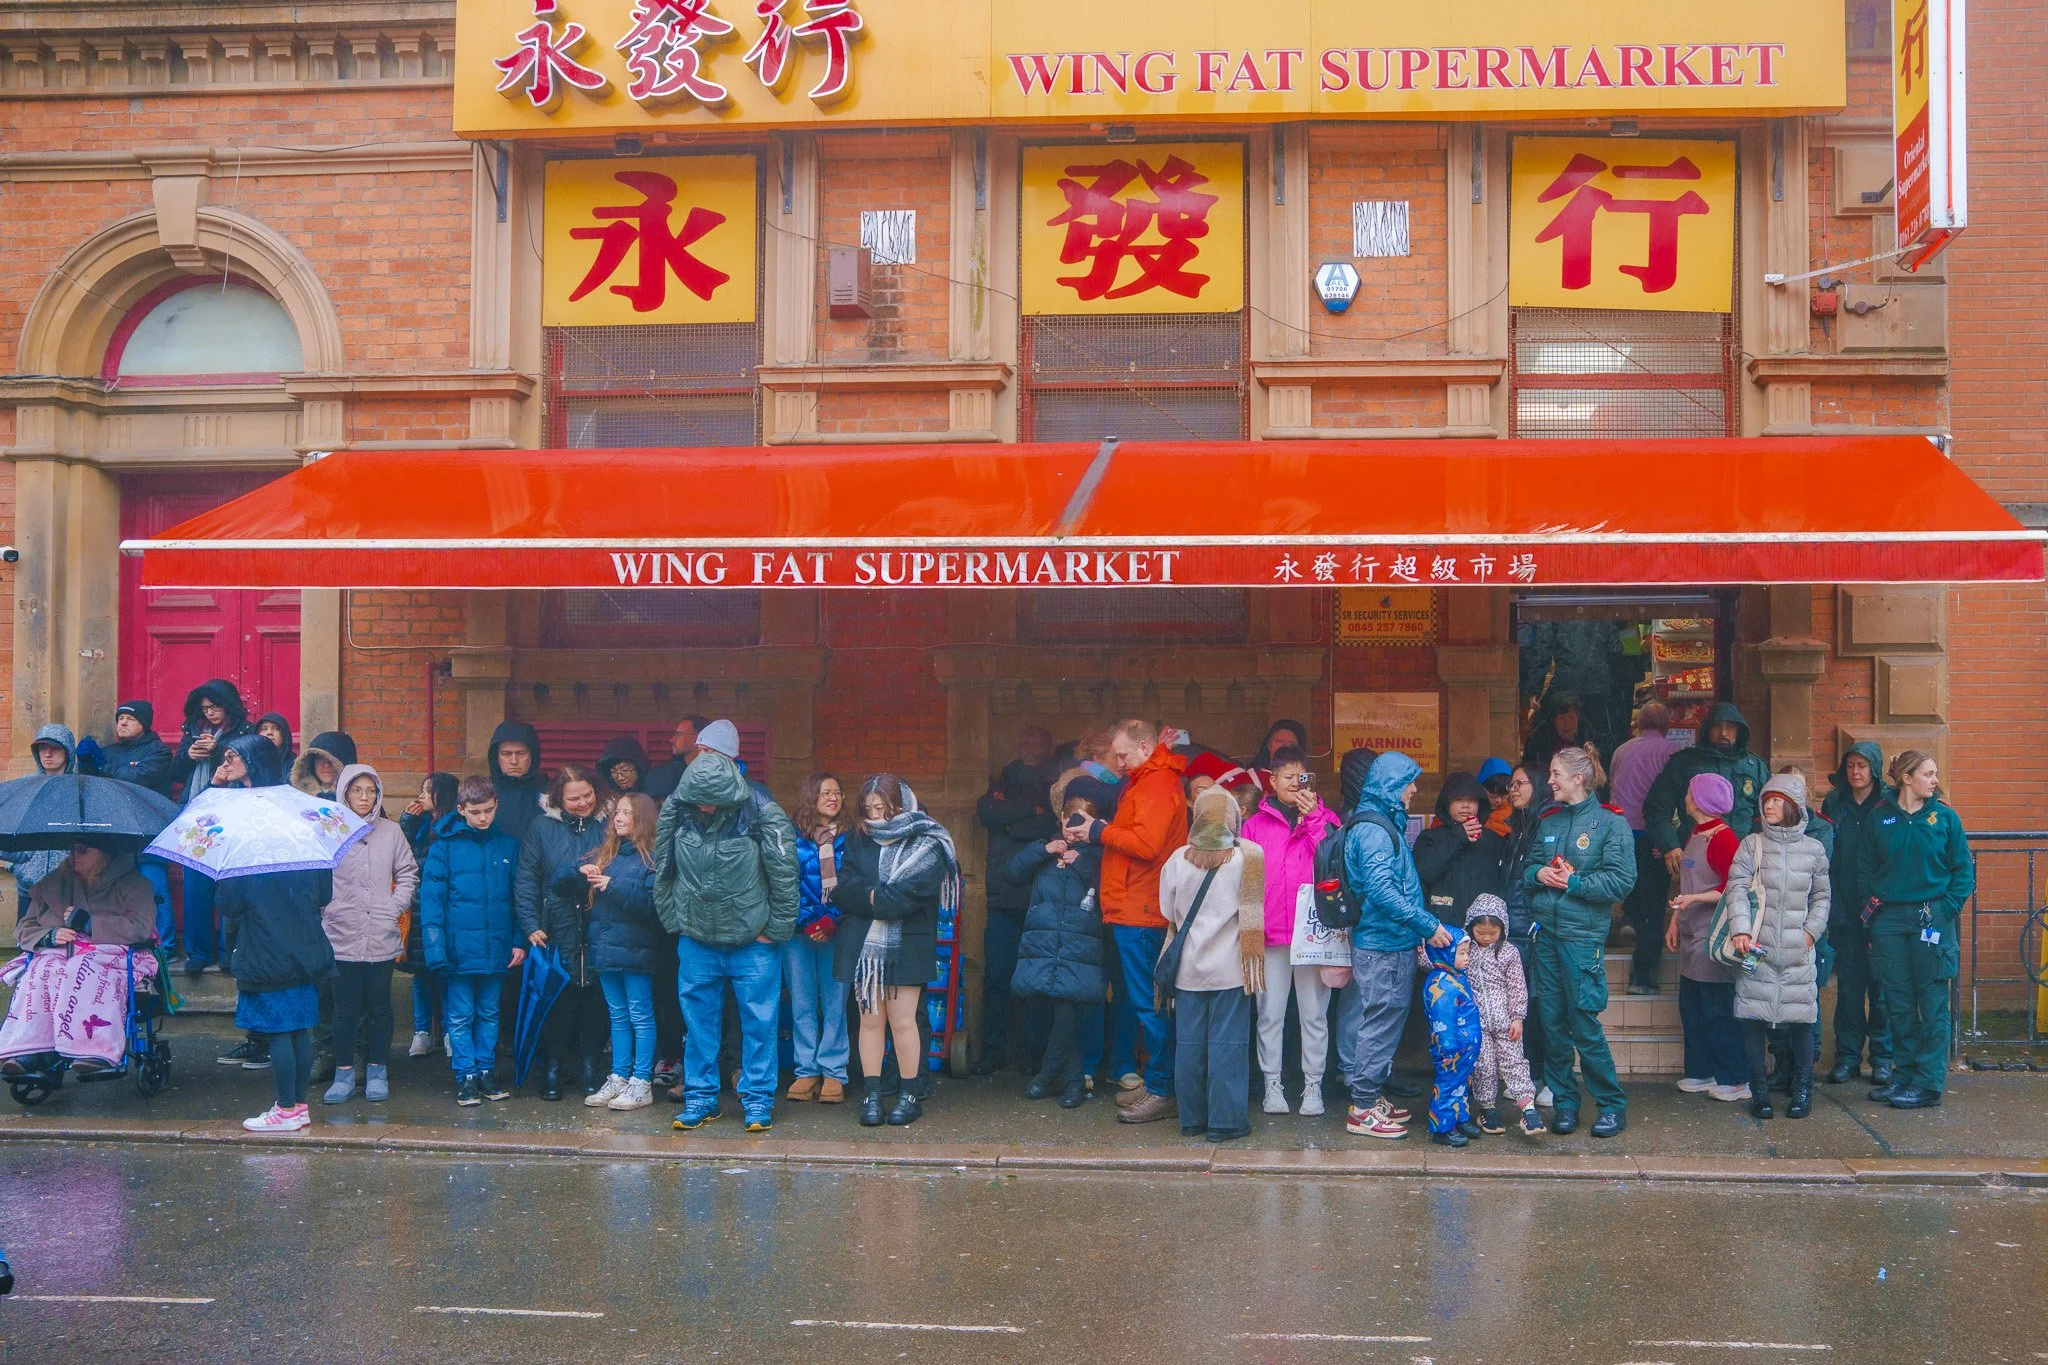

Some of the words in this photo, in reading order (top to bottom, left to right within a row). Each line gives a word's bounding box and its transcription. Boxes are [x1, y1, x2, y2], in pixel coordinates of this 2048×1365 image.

[1006, 50, 1179, 97] WING
[1193, 49, 1303, 93] FAT
[1320, 43, 1785, 92] SUPERMARKET
[1903, 128, 1925, 170] Oriental
[569, 170, 731, 313] 永
[1046, 154, 1219, 302] 發
[1534, 152, 1710, 293] 行
[609, 552, 728, 585] WING
[751, 552, 833, 585] FAT
[854, 551, 1181, 585] SUPERMARKET
[1274, 551, 1538, 584] 永發行超級市場
[1342, 610, 1352, 620] SR
[1354, 610, 1393, 620] SECURITY
[1394, 610, 1430, 620] SERVICES
[1348, 623, 1374, 632] 0845
[1376, 623, 1395, 632] 257
[1399, 623, 1424, 632] 7860
[1350, 738, 1423, 749] WARNING
[73, 952, 96, 993] ardian
[57, 995, 78, 1041] angel,
